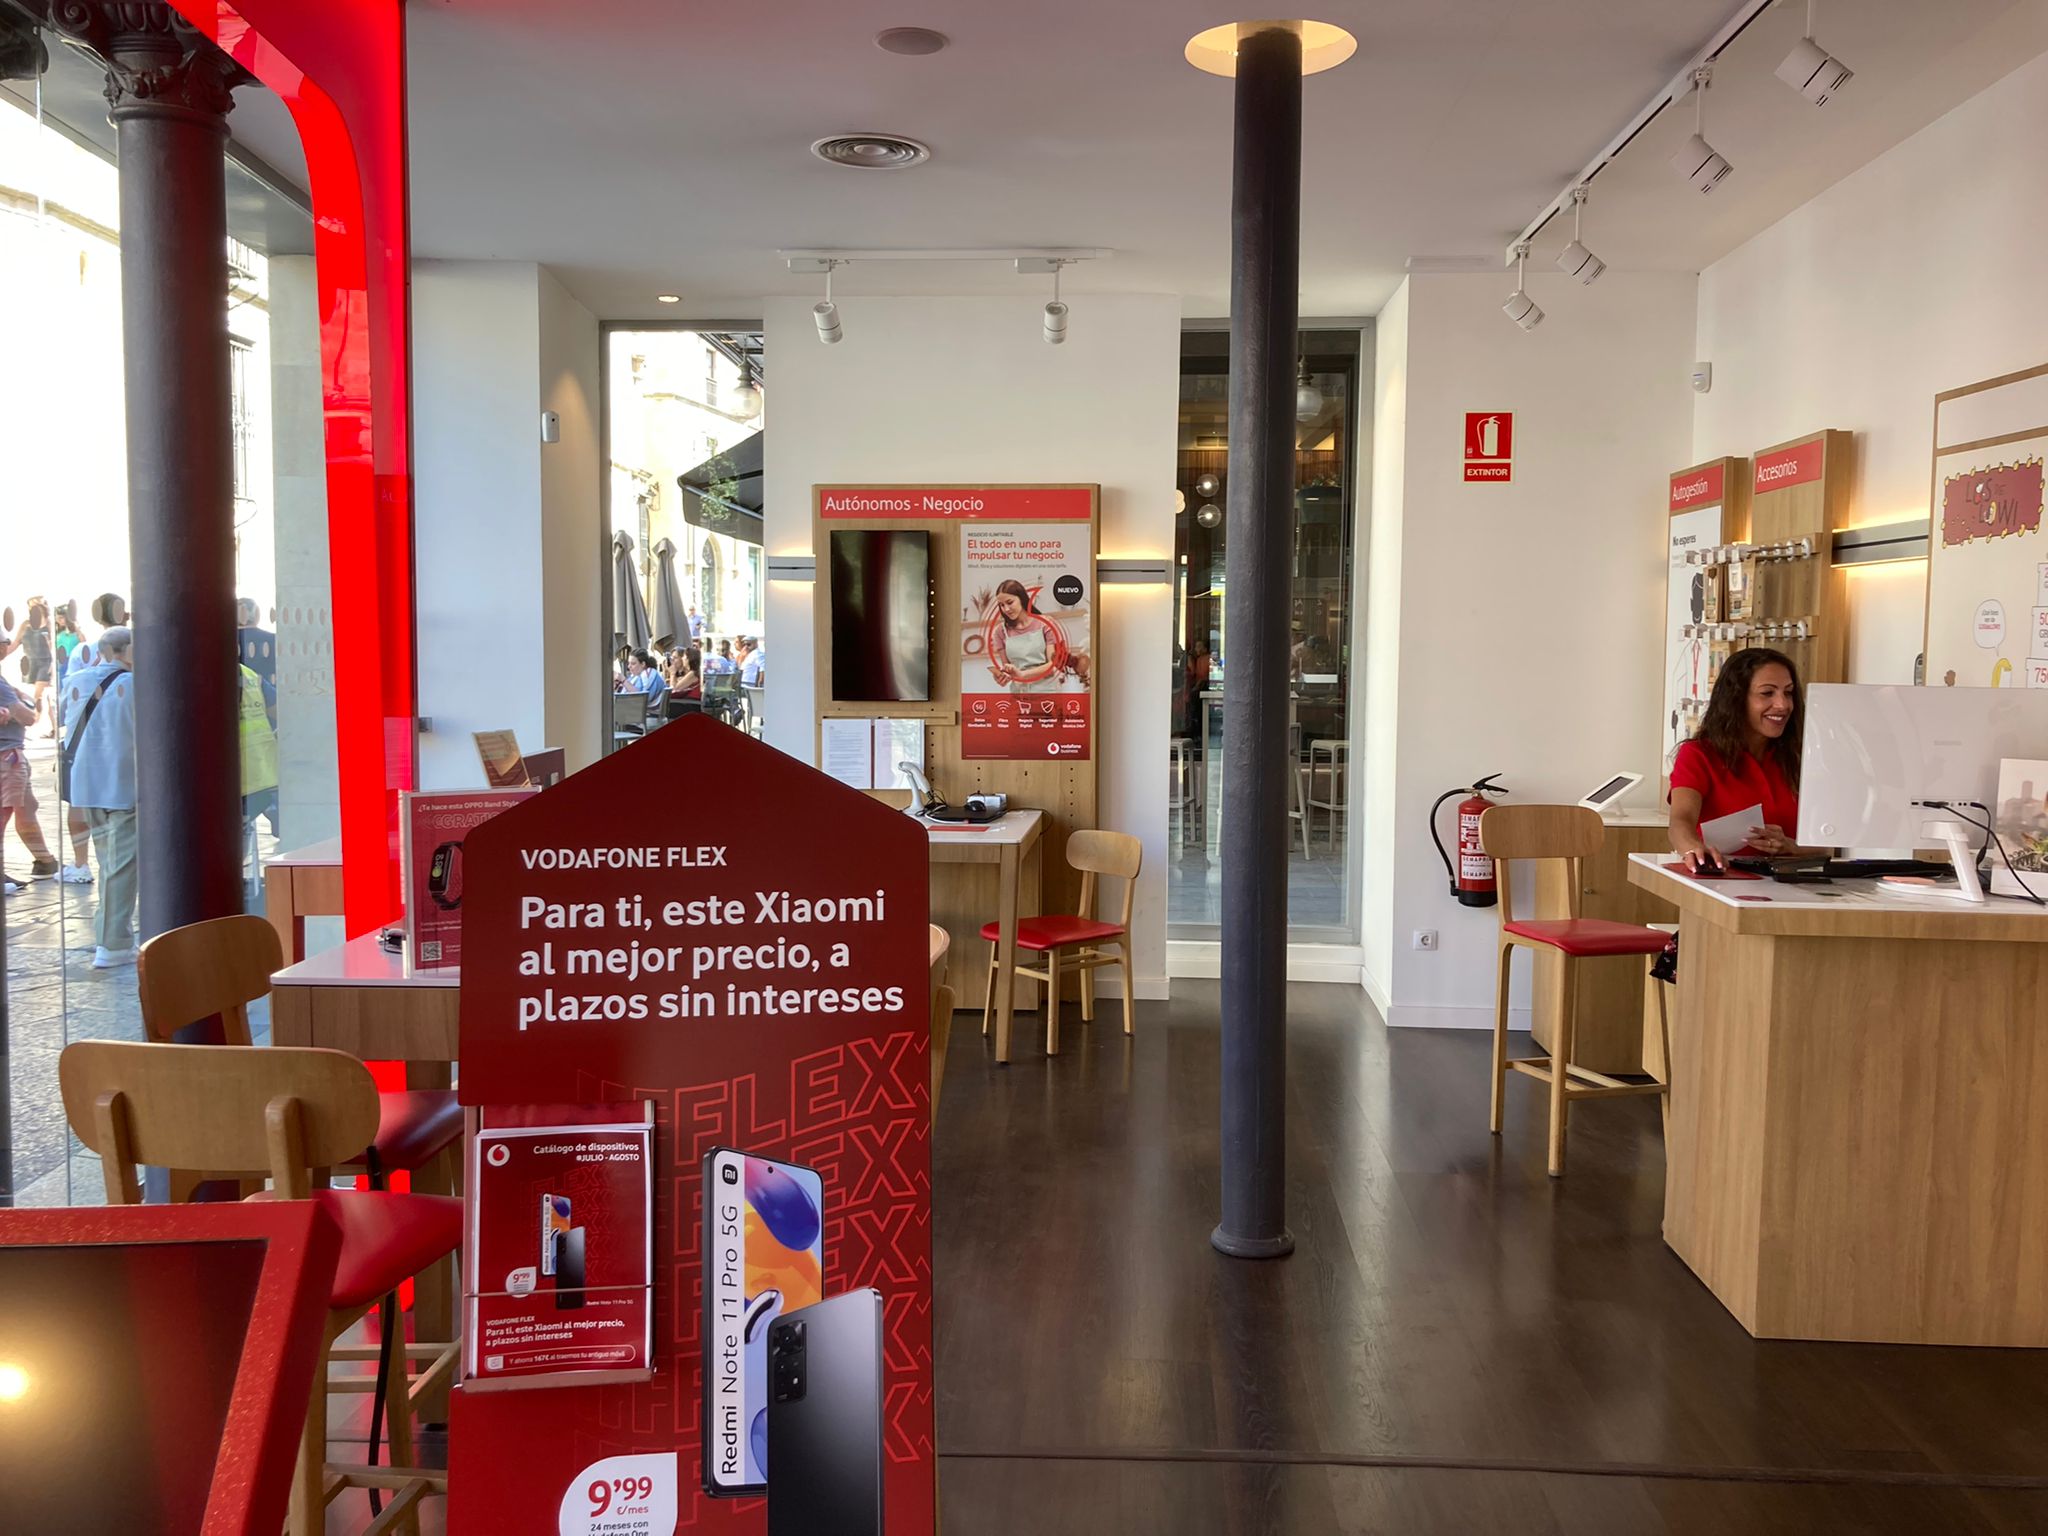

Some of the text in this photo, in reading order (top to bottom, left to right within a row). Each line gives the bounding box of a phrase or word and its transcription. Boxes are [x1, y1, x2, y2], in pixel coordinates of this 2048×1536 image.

[1466, 468, 1508, 476] EXTINTOR
[1757, 458, 1798, 483] Accesorios
[1672, 477, 1708, 502] Autogestión
[825, 496, 911, 511] Autónomos
[922, 496, 984, 514] Negocio
[1979, 498, 2019, 526] LOWI
[967, 539, 1062, 550] El todo en uno para
[967, 550, 1065, 562] impulsar tu negocio
[464, 801, 483, 809] OPPO
[521, 846, 727, 870] VODAFONE FLEX
[521, 890, 885, 931] Para ti, este Xiaomi
[519, 937, 850, 982] al mejor precio, a
[519, 983, 904, 1031] plazos sin intereses
[674, 1031, 917, 1166] FLEX
[533, 1142, 639, 1155] Catálogo de dispositivos
[608, 1153, 640, 1161] AGOSTO
[486, 1317, 519, 1326] VODAFONE
[486, 1328, 504, 1336] Para
[515, 1326, 533, 1334] este
[534, 1322, 562, 1331] Xiaomi
[564, 1321, 572, 1329] al
[574, 1320, 597, 1329] mejor
[598, 1318, 625, 1329] precio,
[492, 1336, 520, 1347] plazos
[521, 1333, 533, 1342] sin
[535, 1331, 573, 1341] intereses
[722, 1205, 738, 1475] Redmi Note 11 Pro 5G
[588, 1476, 652, 1518] 9'99
[617, 1505, 649, 1515] €/mes
[591, 1523, 602, 1531] 24
[603, 1522, 631, 1530] meses
